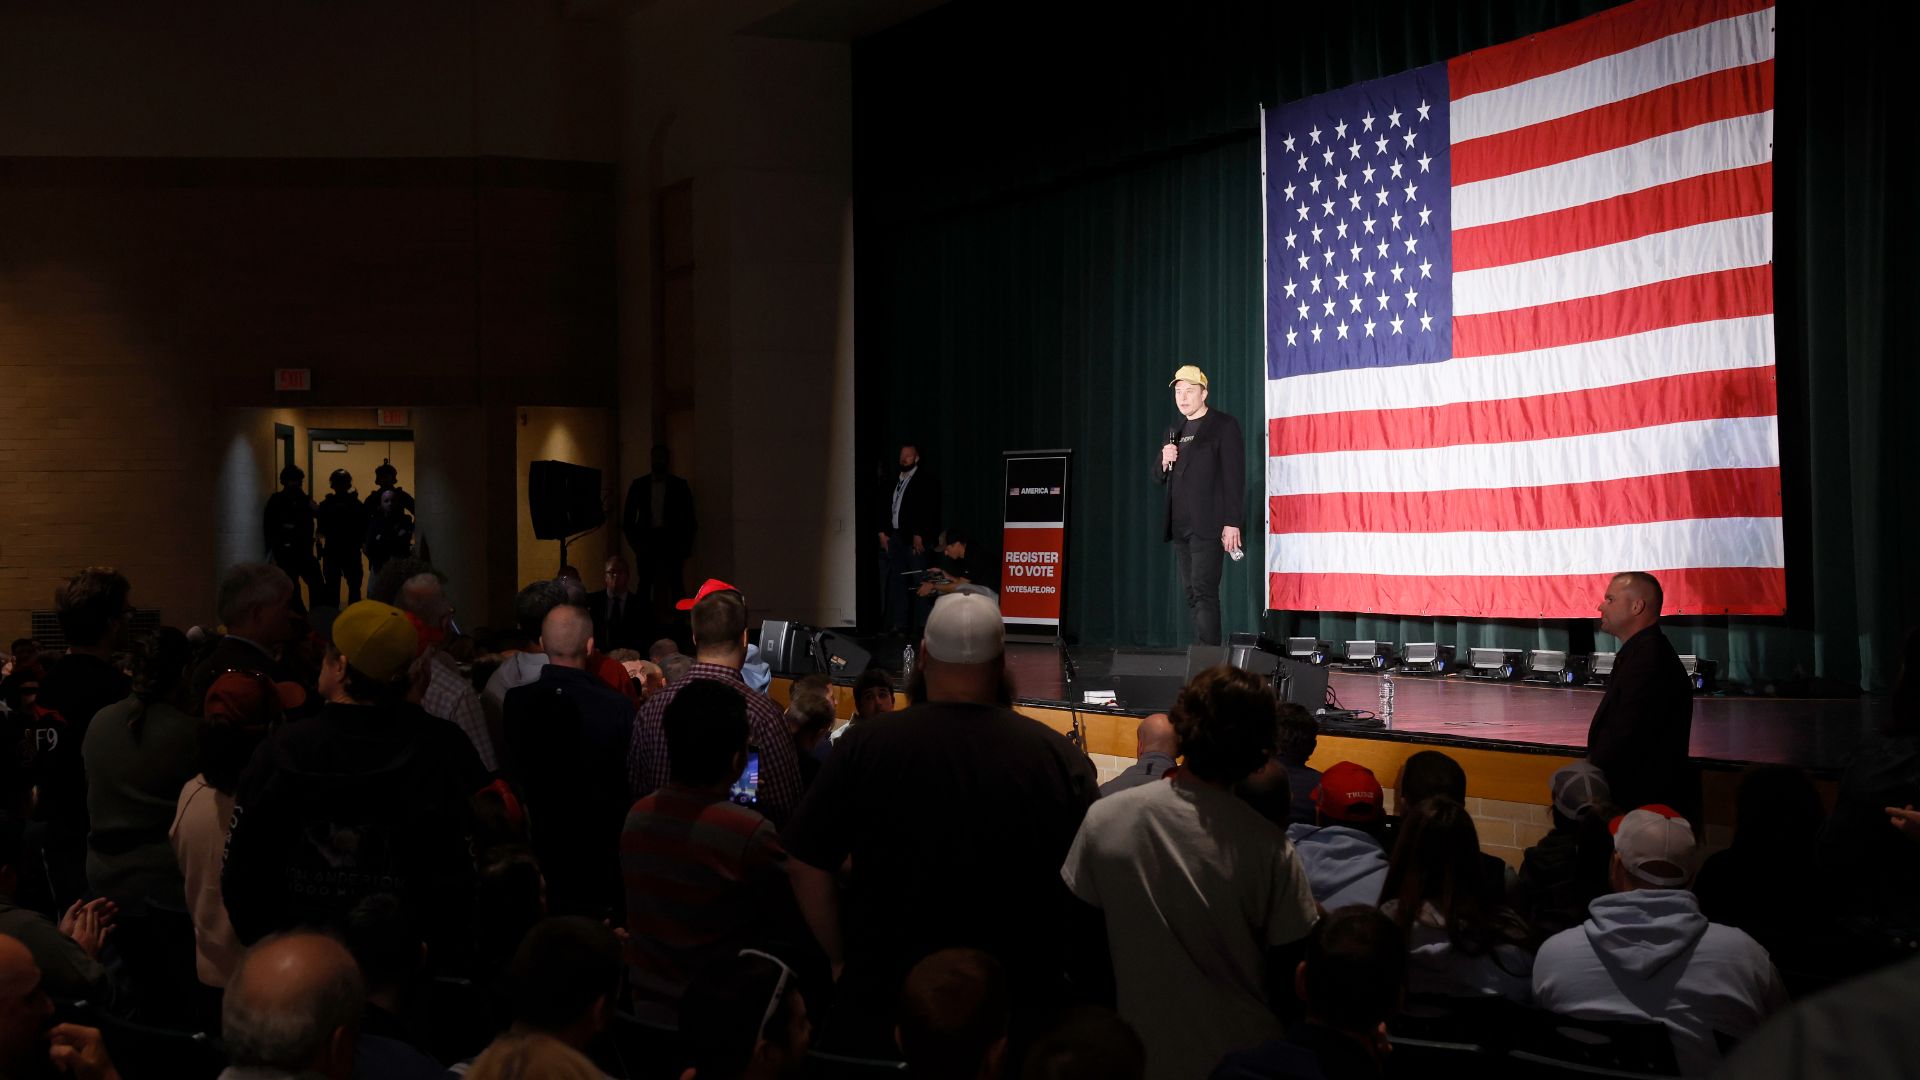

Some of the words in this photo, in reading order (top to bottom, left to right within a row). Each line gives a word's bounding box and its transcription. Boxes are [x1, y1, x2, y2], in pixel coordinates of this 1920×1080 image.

[280, 370, 305, 388] EXIT
[1021, 487, 1049, 495] AMERICA
[1005, 551, 1059, 563] REGISTER
[1009, 565, 1024, 577] TO
[1025, 565, 1054, 577] VOTE
[1005, 585, 1056, 594] VOTESAFE.ORG
